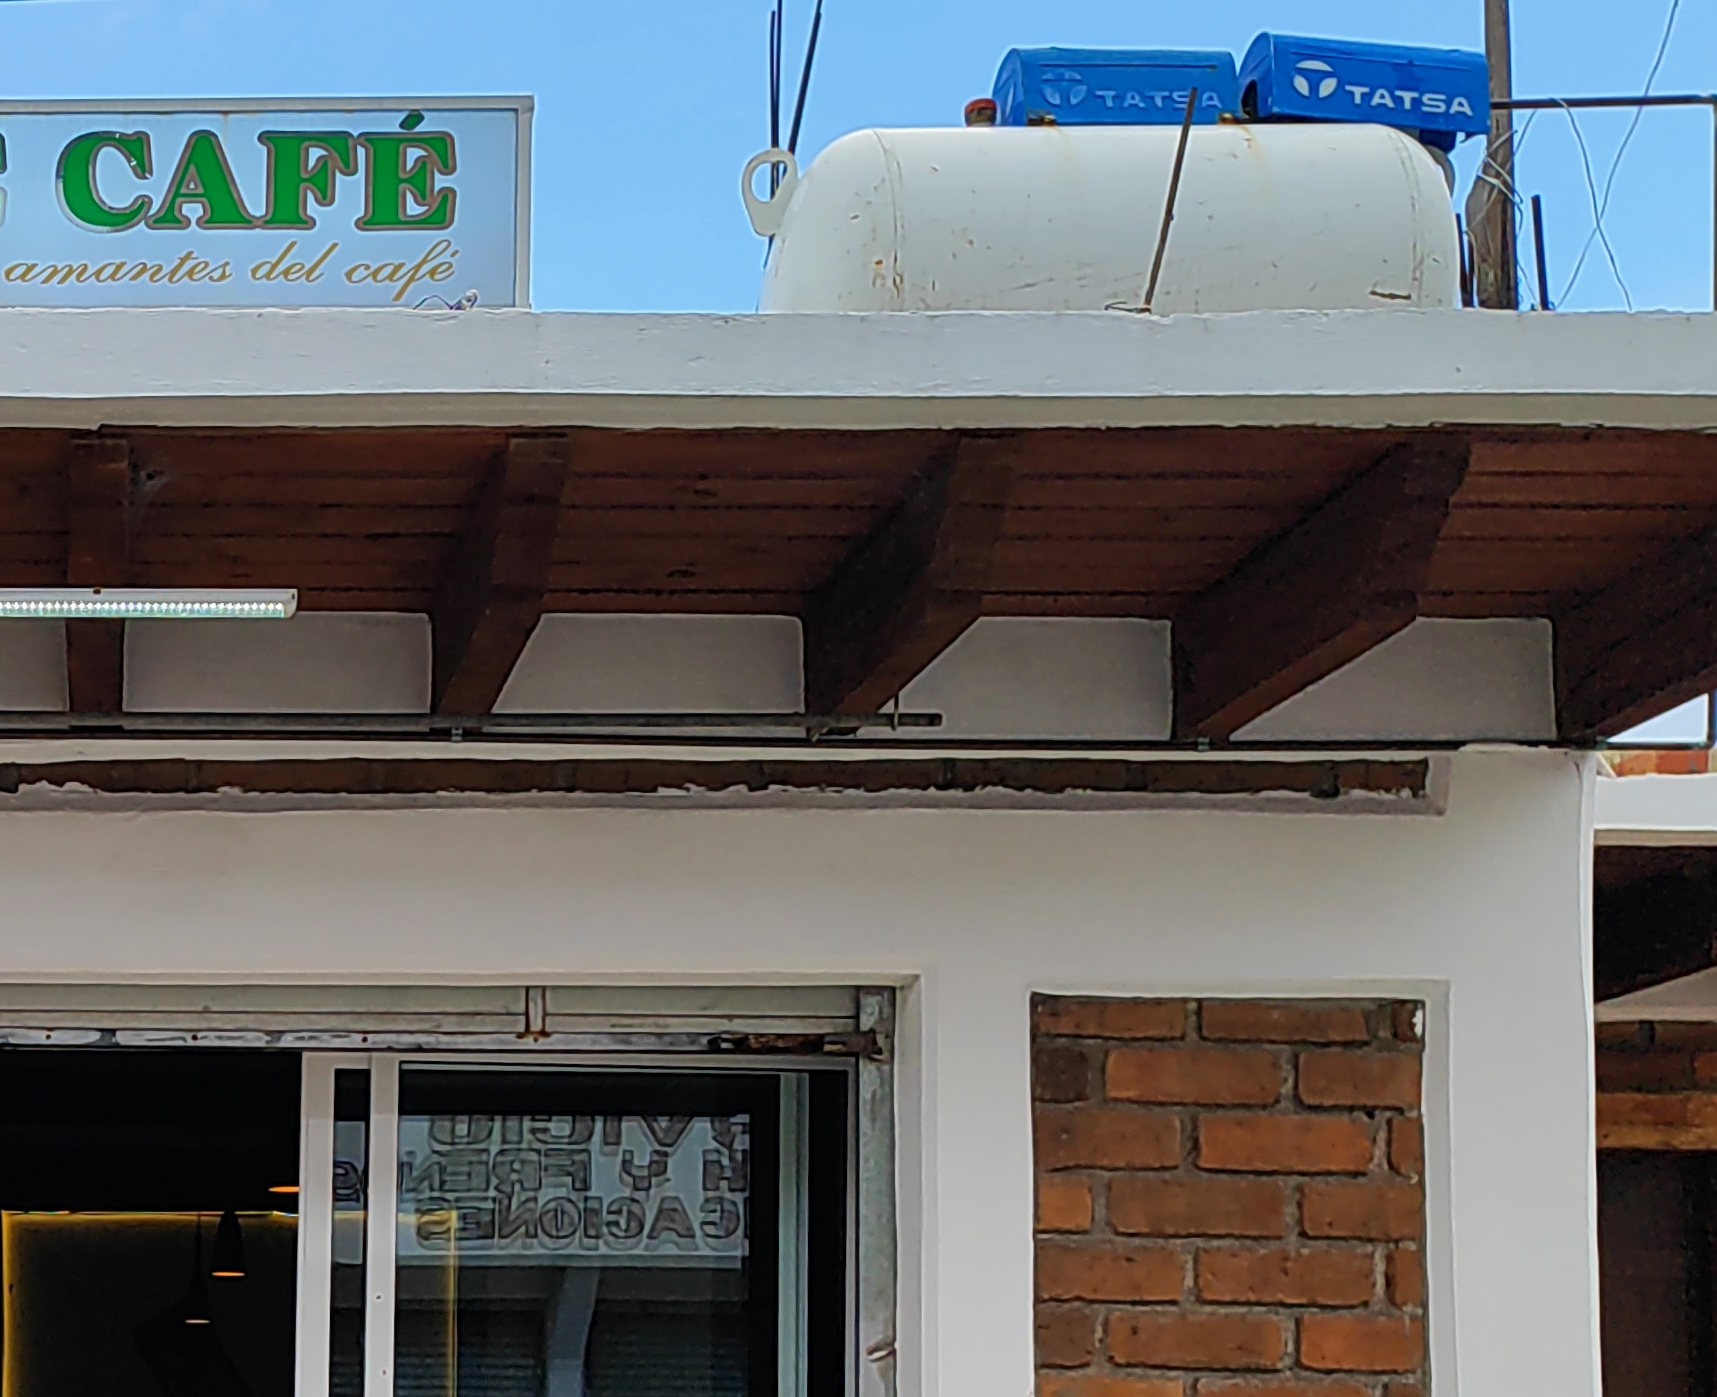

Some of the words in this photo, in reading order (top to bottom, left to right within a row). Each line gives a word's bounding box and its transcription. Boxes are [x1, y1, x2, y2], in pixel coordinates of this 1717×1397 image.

[1094, 89, 1223, 112] TATSA
[1344, 83, 1475, 118] TATSA
[54, 110, 460, 233] CAFÉ
[3, 247, 235, 285] amantes
[249, 240, 339, 284] del
[343, 239, 459, 301] café
